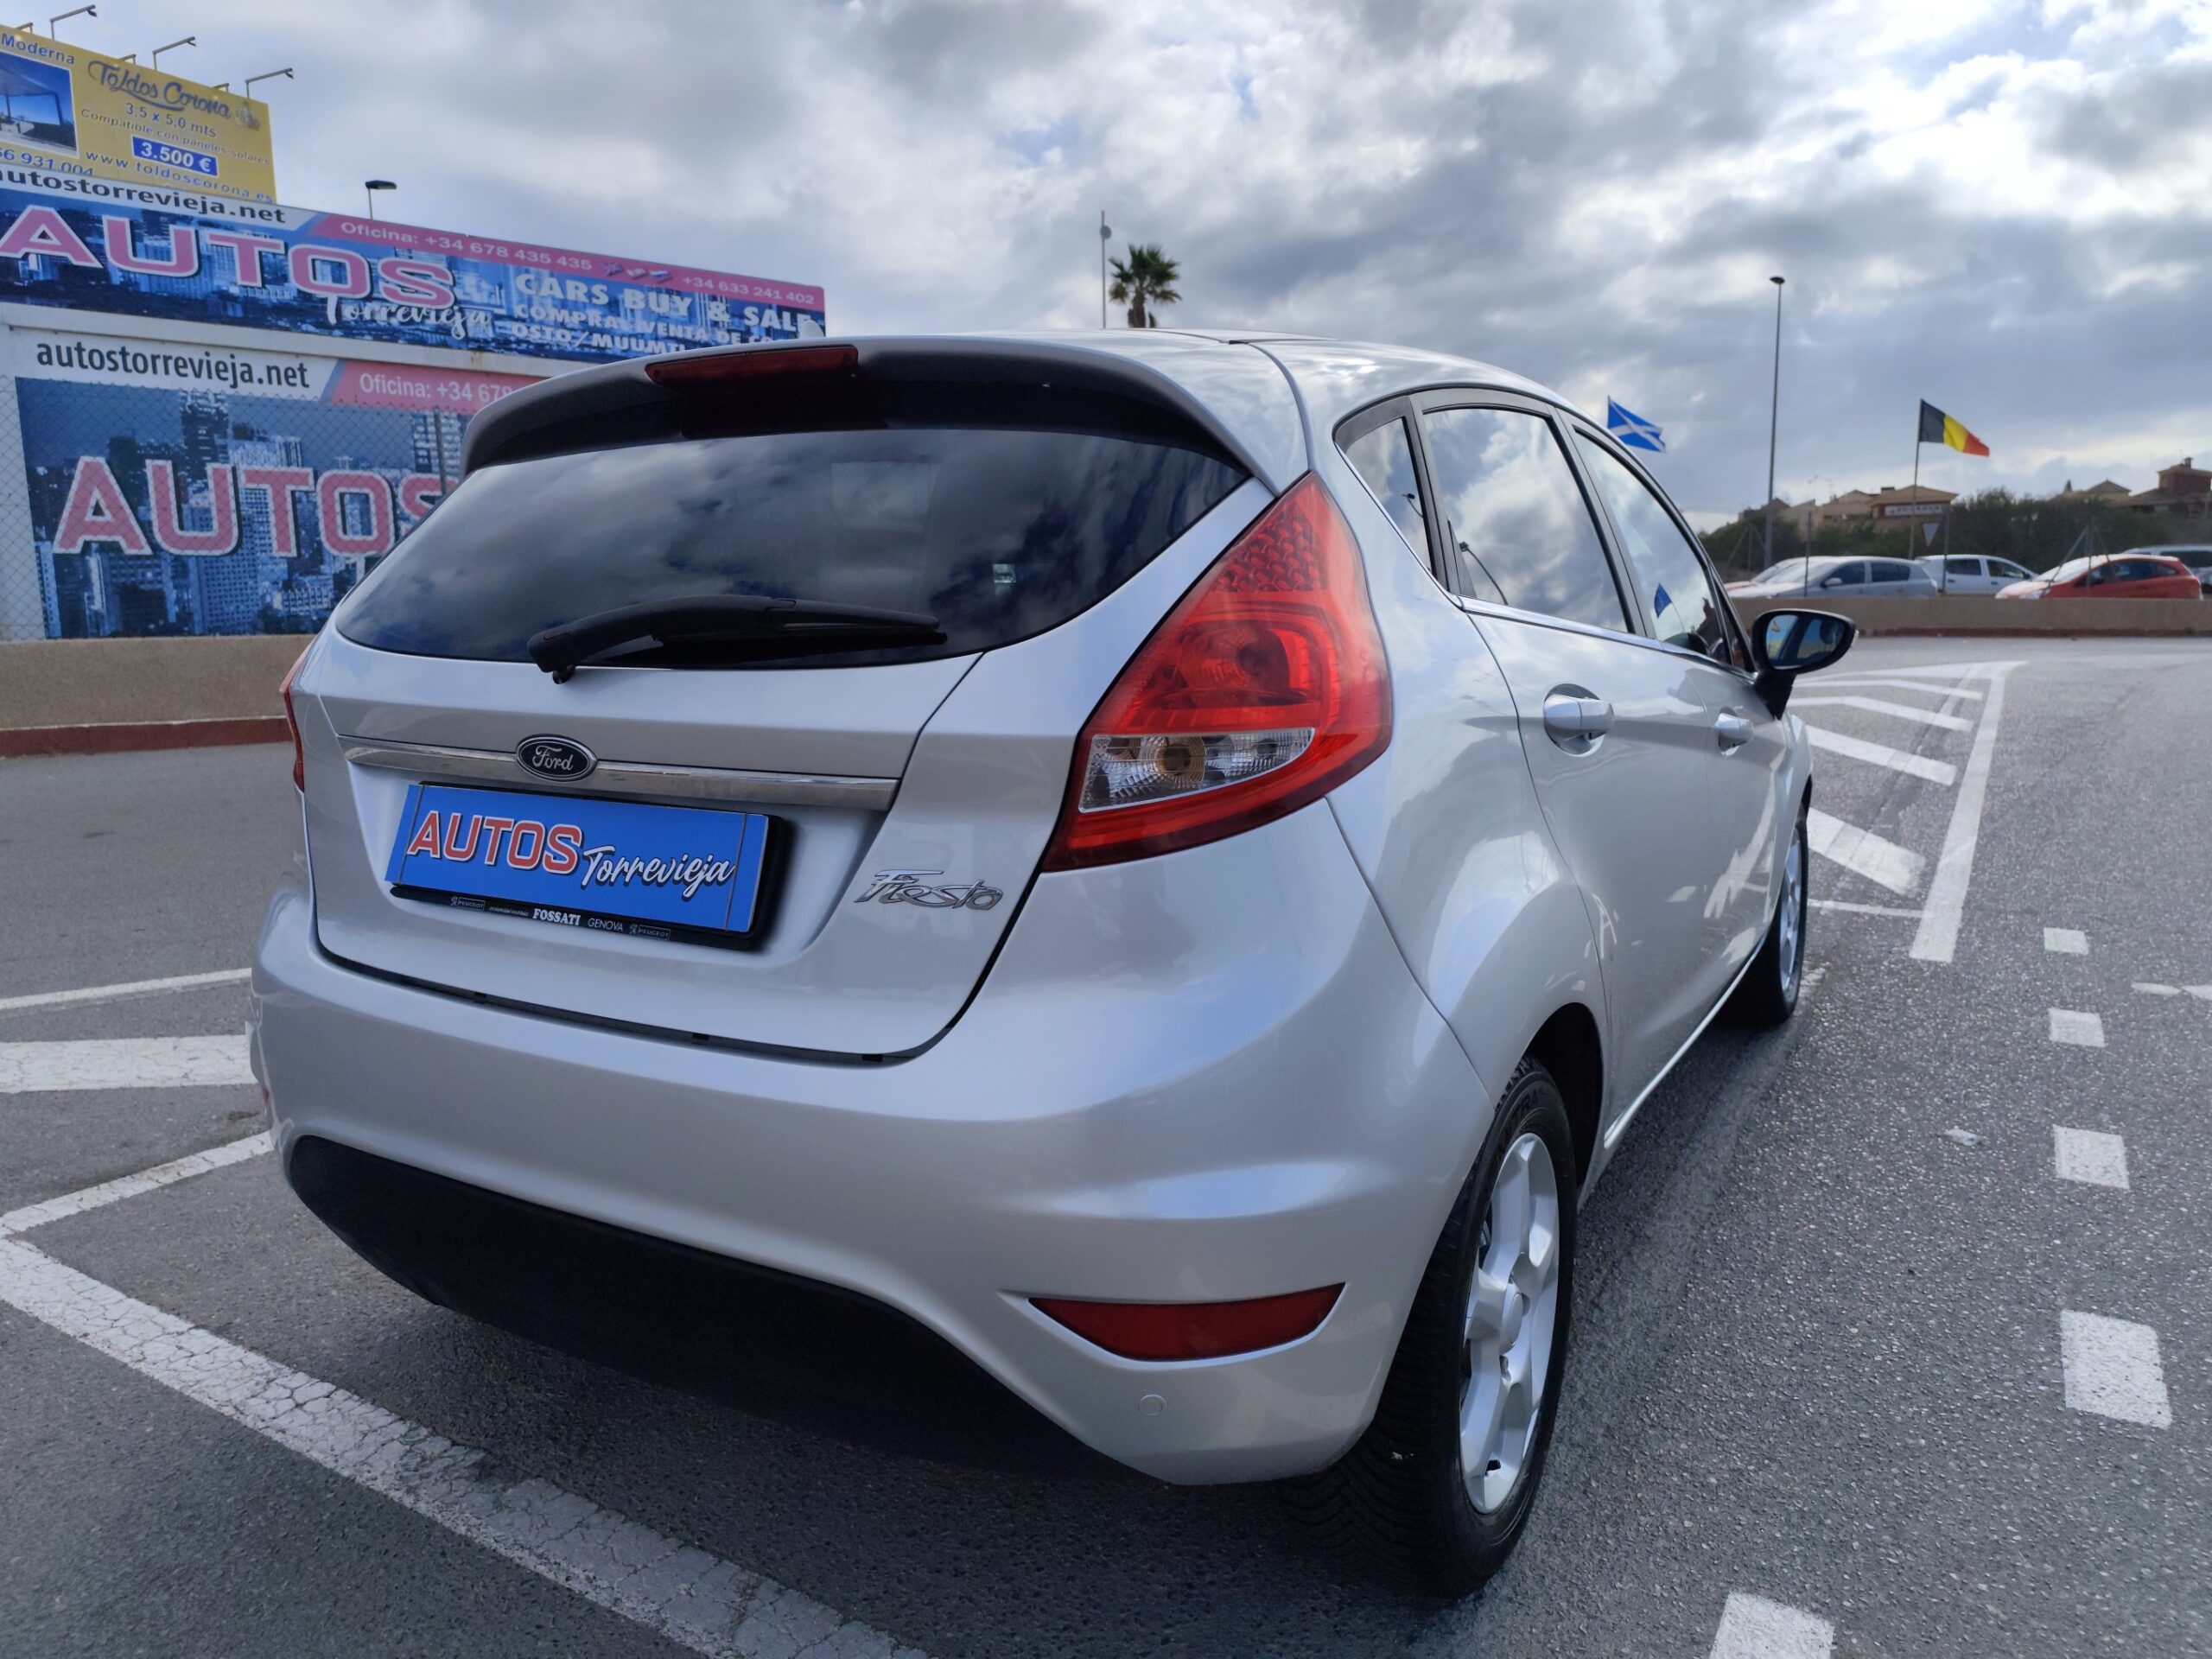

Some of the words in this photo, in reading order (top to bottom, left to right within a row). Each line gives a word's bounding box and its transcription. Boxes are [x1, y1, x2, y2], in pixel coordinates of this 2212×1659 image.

[2, 33, 75, 64] Moderna
[87, 60, 161, 100] Toldos
[163, 81, 231, 119] Corona
[81, 108, 152, 134] Compatible
[156, 130, 180, 142] con
[182, 137, 227, 155] paneles
[152, 113, 160, 122] x
[21, 153, 54, 171] 931
[60, 162, 94, 176] 004
[141, 142, 194, 168] 3.500
[199, 157, 213, 173] €
[0, 170, 285, 223] utostorrevieja.net
[0, 204, 456, 308] AUTOS
[341, 221, 418, 244] Oficina:
[425, 236, 465, 251] +34
[470, 242, 508, 258] 678
[514, 248, 552, 264] 435
[557, 255, 593, 271] 435
[516, 273, 609, 305] CARS
[624, 288, 692, 317] BUY
[709, 301, 730, 322] &
[682, 276, 715, 289] +34
[719, 281, 749, 295] 633
[753, 287, 782, 301] 241
[786, 292, 815, 305] 402
[320, 294, 491, 340] Torrevieja
[516, 303, 620, 329] COMPRA
[639, 319, 709, 342] VENTA
[716, 330, 741, 344] DE
[37, 341, 309, 389] autostorrevieja.net
[359, 372, 431, 398] Oficina:
[436, 381, 473, 401] +34
[531, 745, 575, 771] Ford
[407, 810, 582, 874] AUTOS
[582, 845, 735, 899] Torrevieja
[854, 869, 1003, 911] Fiesta
[532, 908, 581, 925] FOSSATI
[588, 918, 623, 931] GENOVA
[639, 928, 669, 938] PEUGEOT
